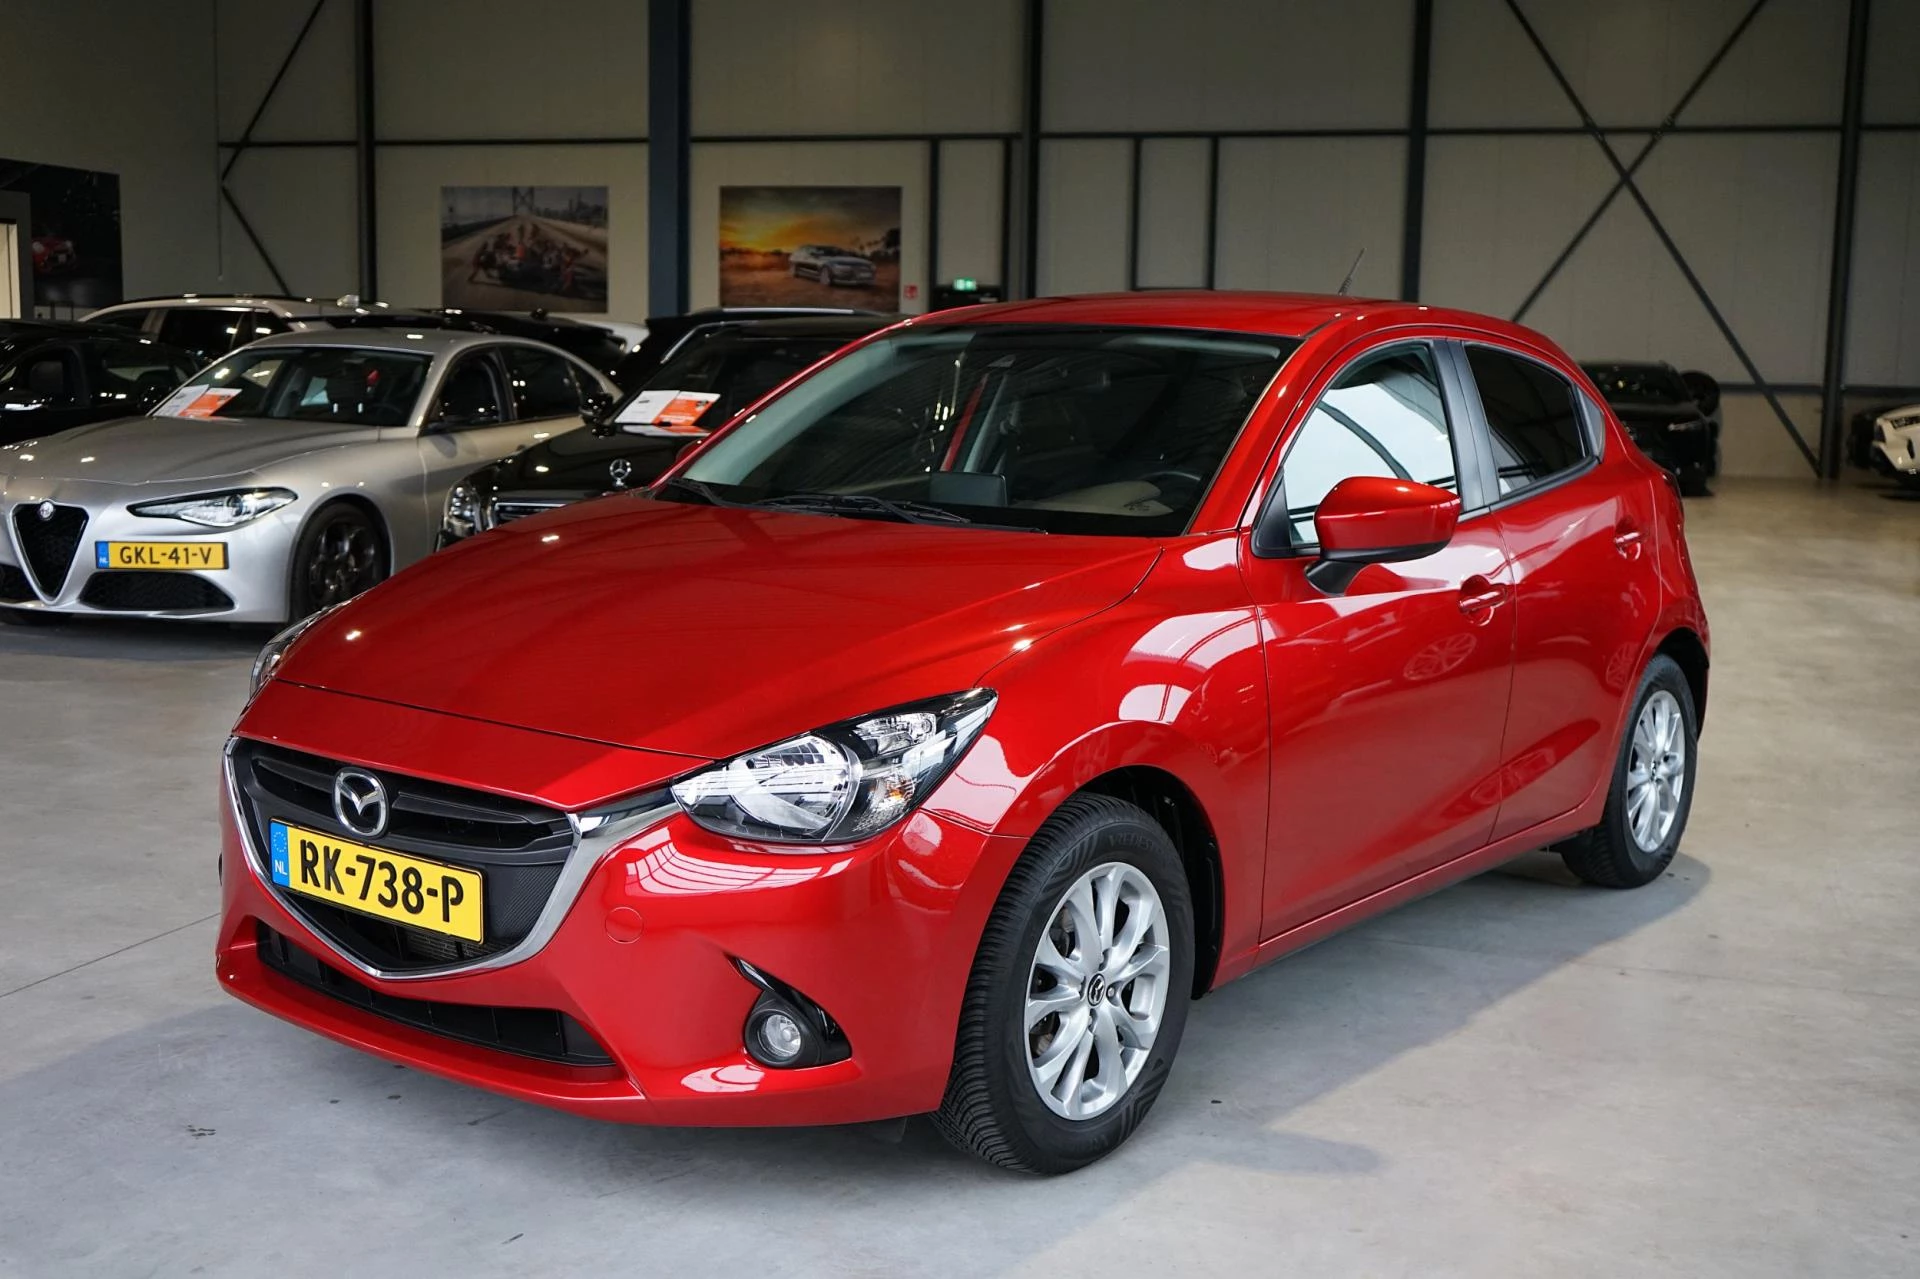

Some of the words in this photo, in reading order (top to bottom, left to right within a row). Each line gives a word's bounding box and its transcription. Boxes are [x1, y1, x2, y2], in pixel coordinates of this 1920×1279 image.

[119, 546, 212, 565] GKL-41-V
[274, 859, 288, 876] NL
[299, 838, 464, 923] RK-738-P
